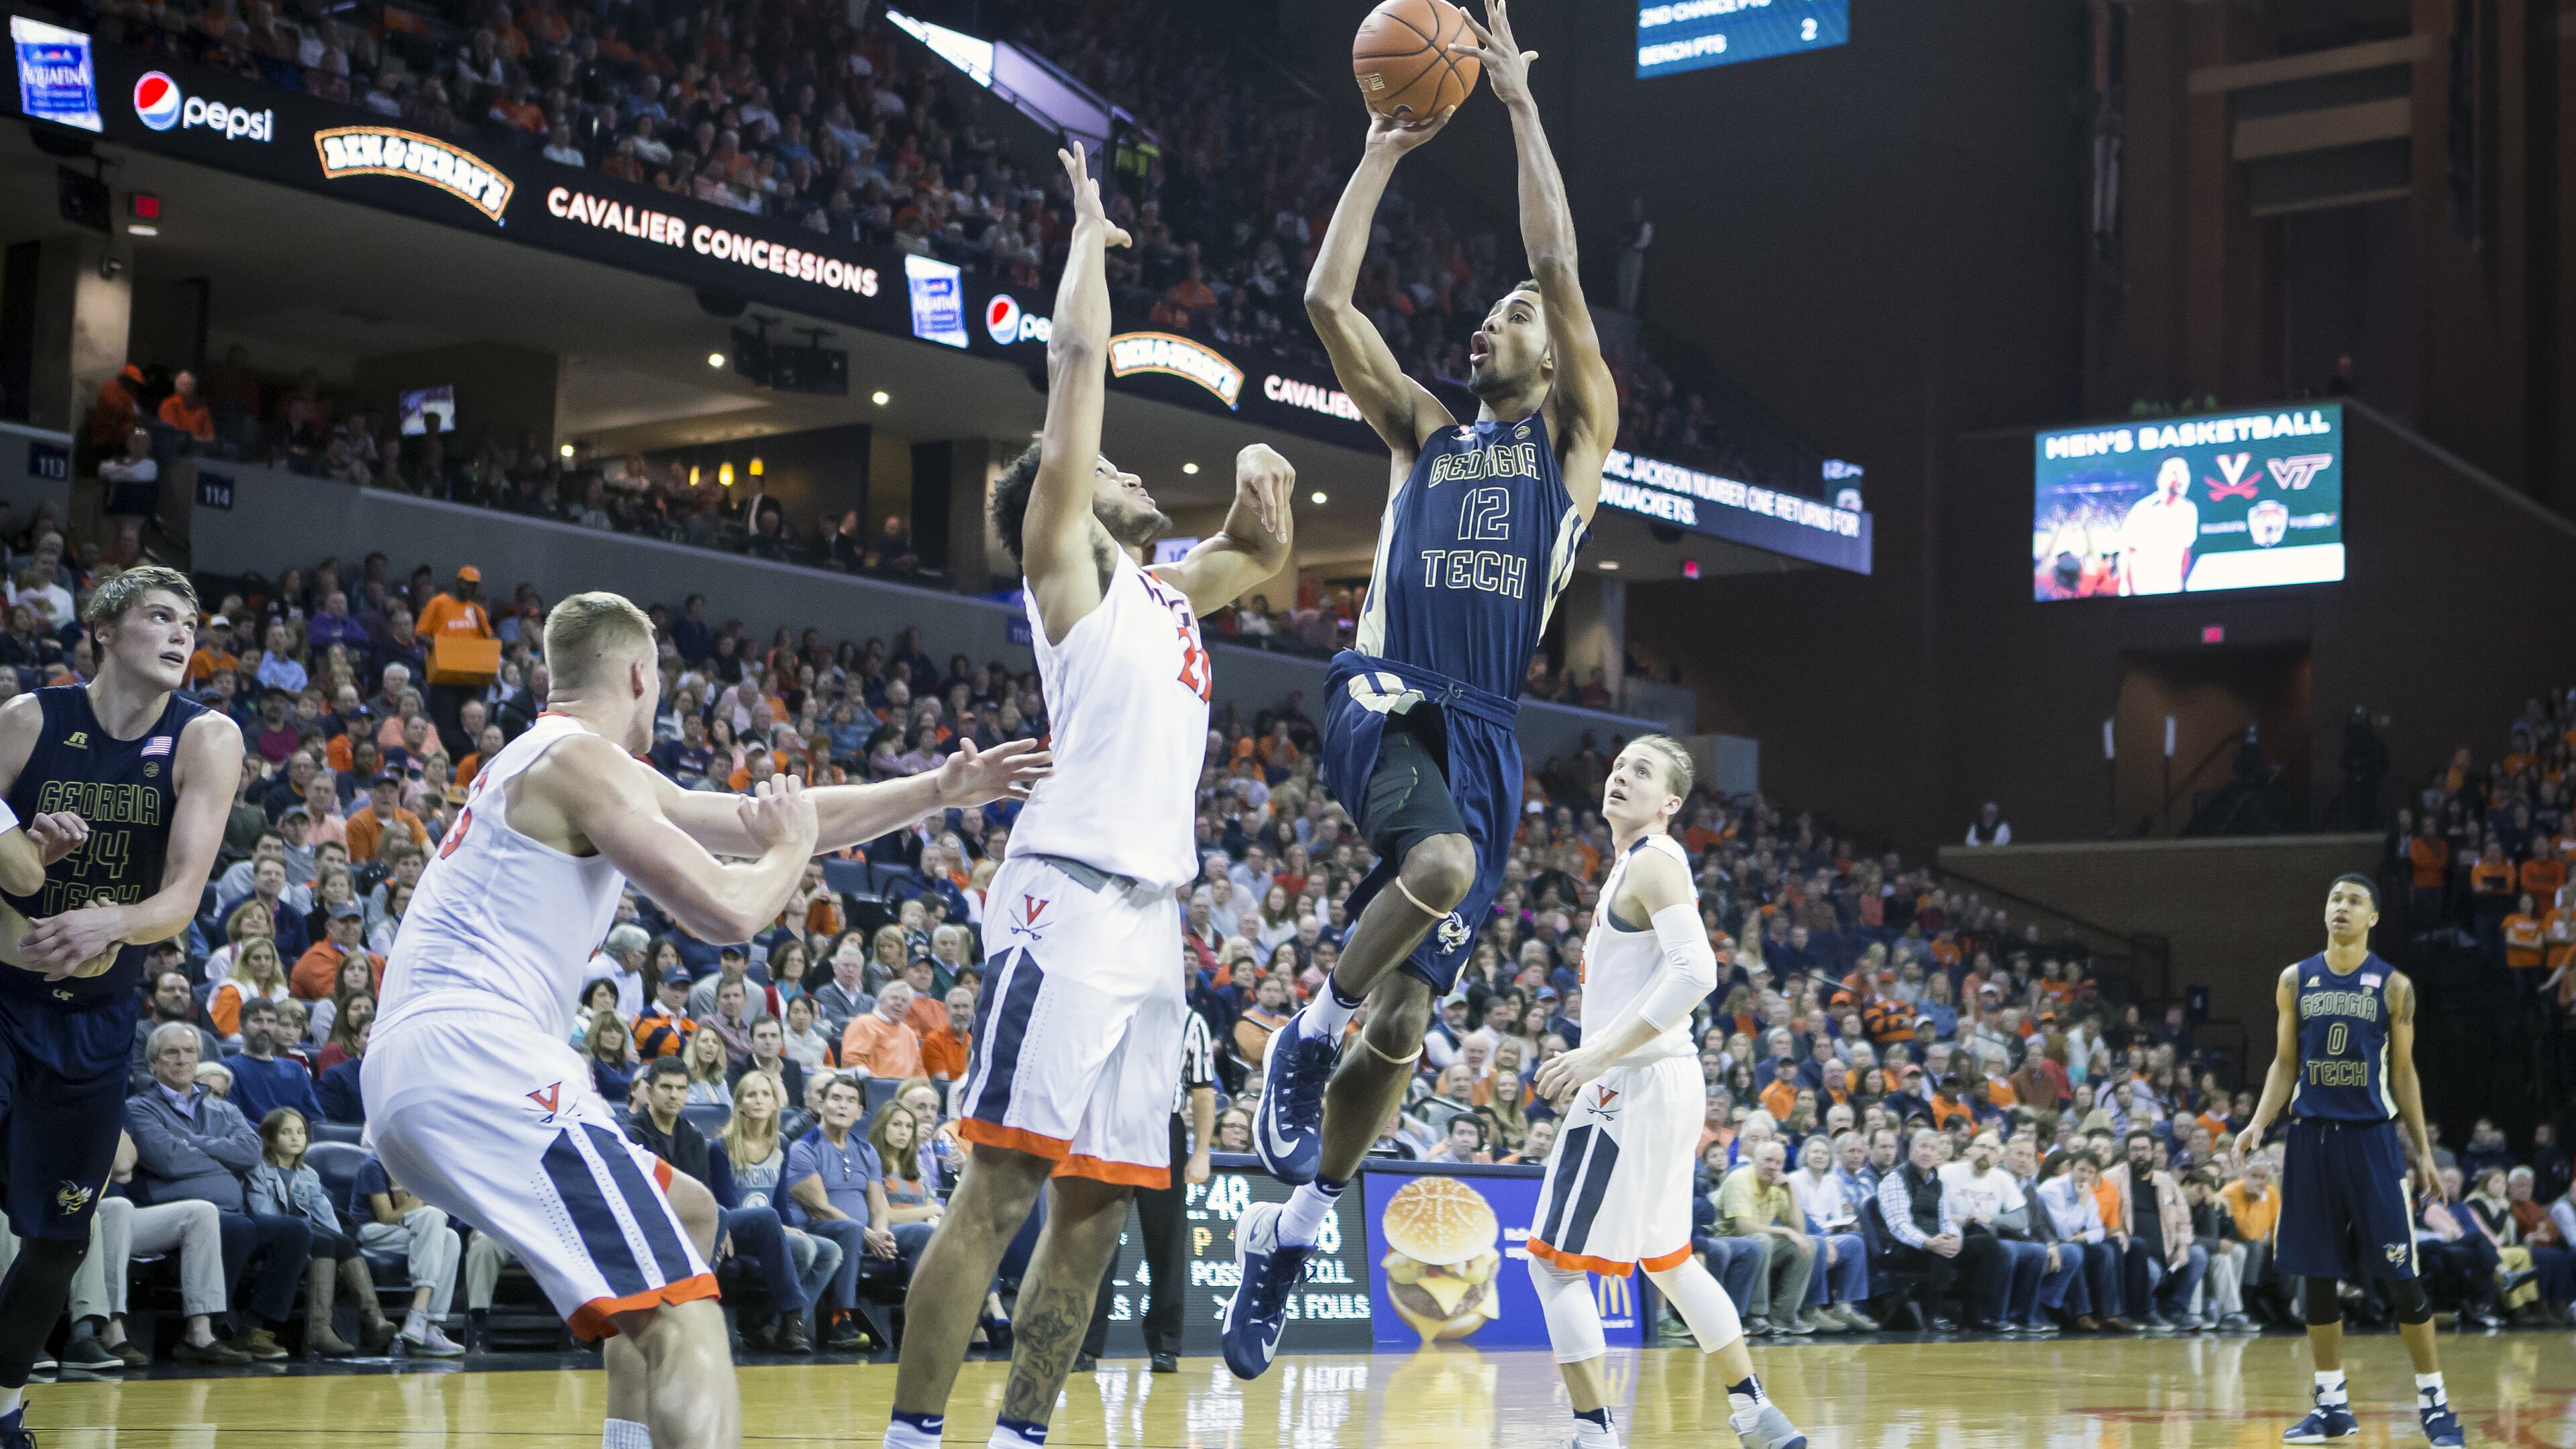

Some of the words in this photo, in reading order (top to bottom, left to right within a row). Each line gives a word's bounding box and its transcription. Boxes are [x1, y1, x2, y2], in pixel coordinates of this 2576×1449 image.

[1638, 40, 1693, 66] BENCH
[1692, 34, 1727, 57] PTS
[1801, 17, 1818, 41] 2
[183, 96, 274, 143] pepsi
[547, 186, 686, 248] CAVALIER
[692, 225, 878, 297] CONCESSIONS
[2045, 429, 2134, 460] MEN'S
[2139, 410, 2331, 451] BASKETBALL
[41, 458, 65, 478] 113
[1428, 443, 1541, 488] GEORGIA
[2267, 453, 2333, 490] VT
[206, 486, 229, 505] 114
[1458, 487, 1509, 540] 12
[1631, 456, 1692, 495] JACKSON
[1692, 472, 1748, 509] NUMBER
[1748, 486, 1775, 517] ONE
[1775, 493, 1833, 531] RETURNS
[1833, 508, 1860, 538] FOR
[1421, 549, 1527, 599] TECH
[36, 781, 160, 826] GEORGIA
[64, 829, 131, 879] 44
[2300, 991, 2377, 1022] GEORGIA
[2327, 1022, 2348, 1055] 0
[2307, 1061, 2367, 1087] TECH
